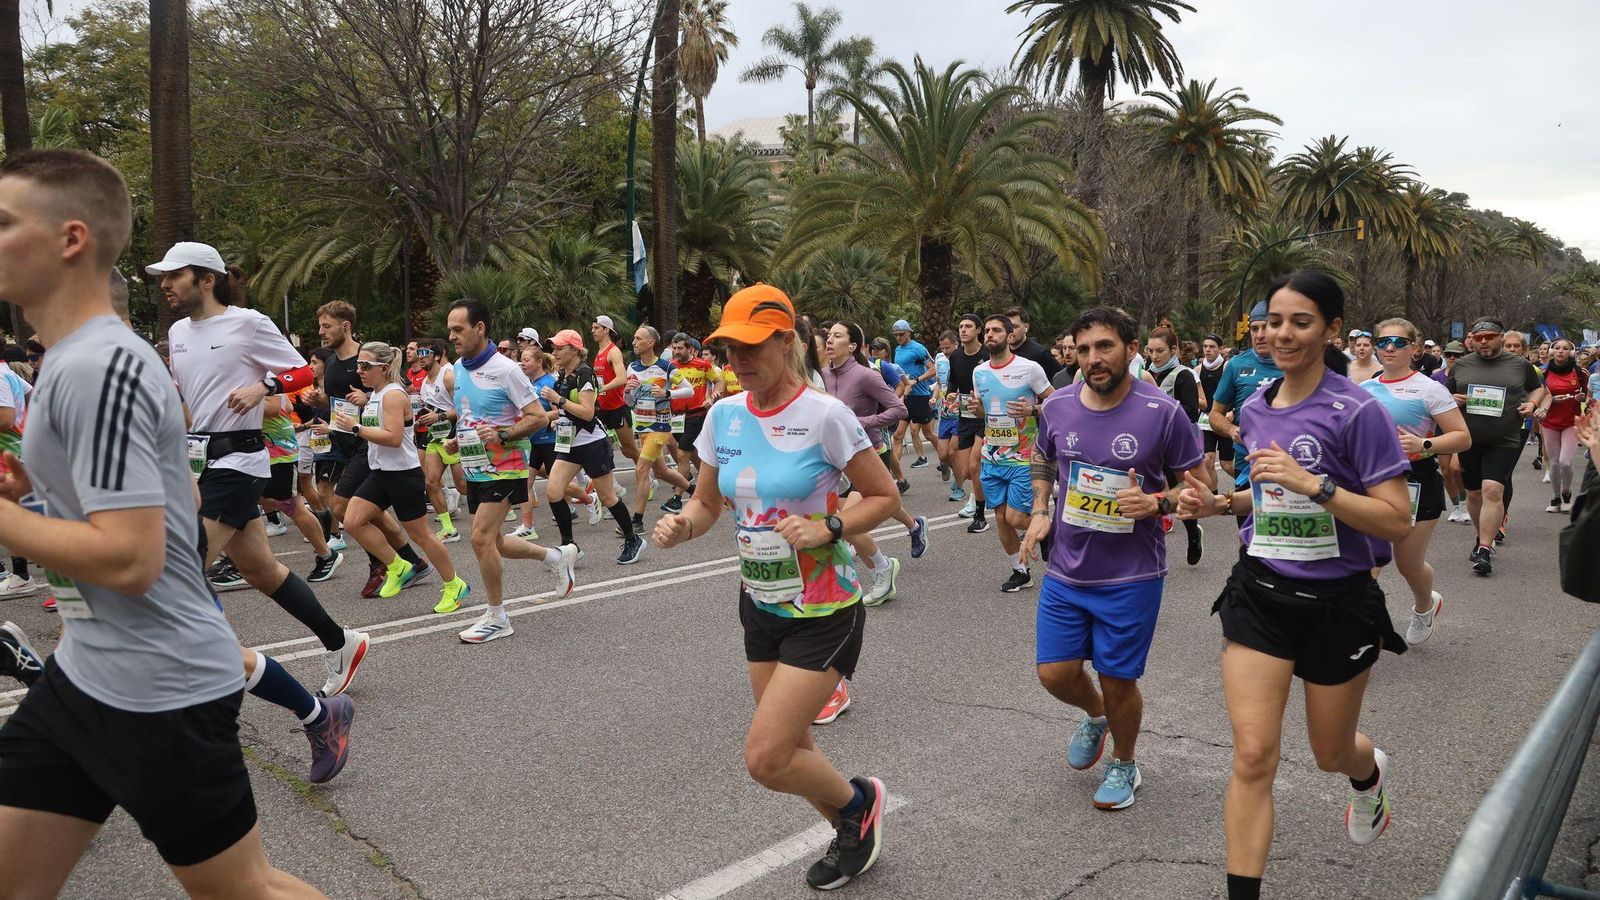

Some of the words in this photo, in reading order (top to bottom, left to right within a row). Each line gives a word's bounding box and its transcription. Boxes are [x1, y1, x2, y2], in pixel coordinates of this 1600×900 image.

[991, 429, 1012, 438] 2548
[1079, 495, 1123, 516] 2714
[1267, 517, 1318, 538] 5982
[744, 559, 783, 580] 5367
